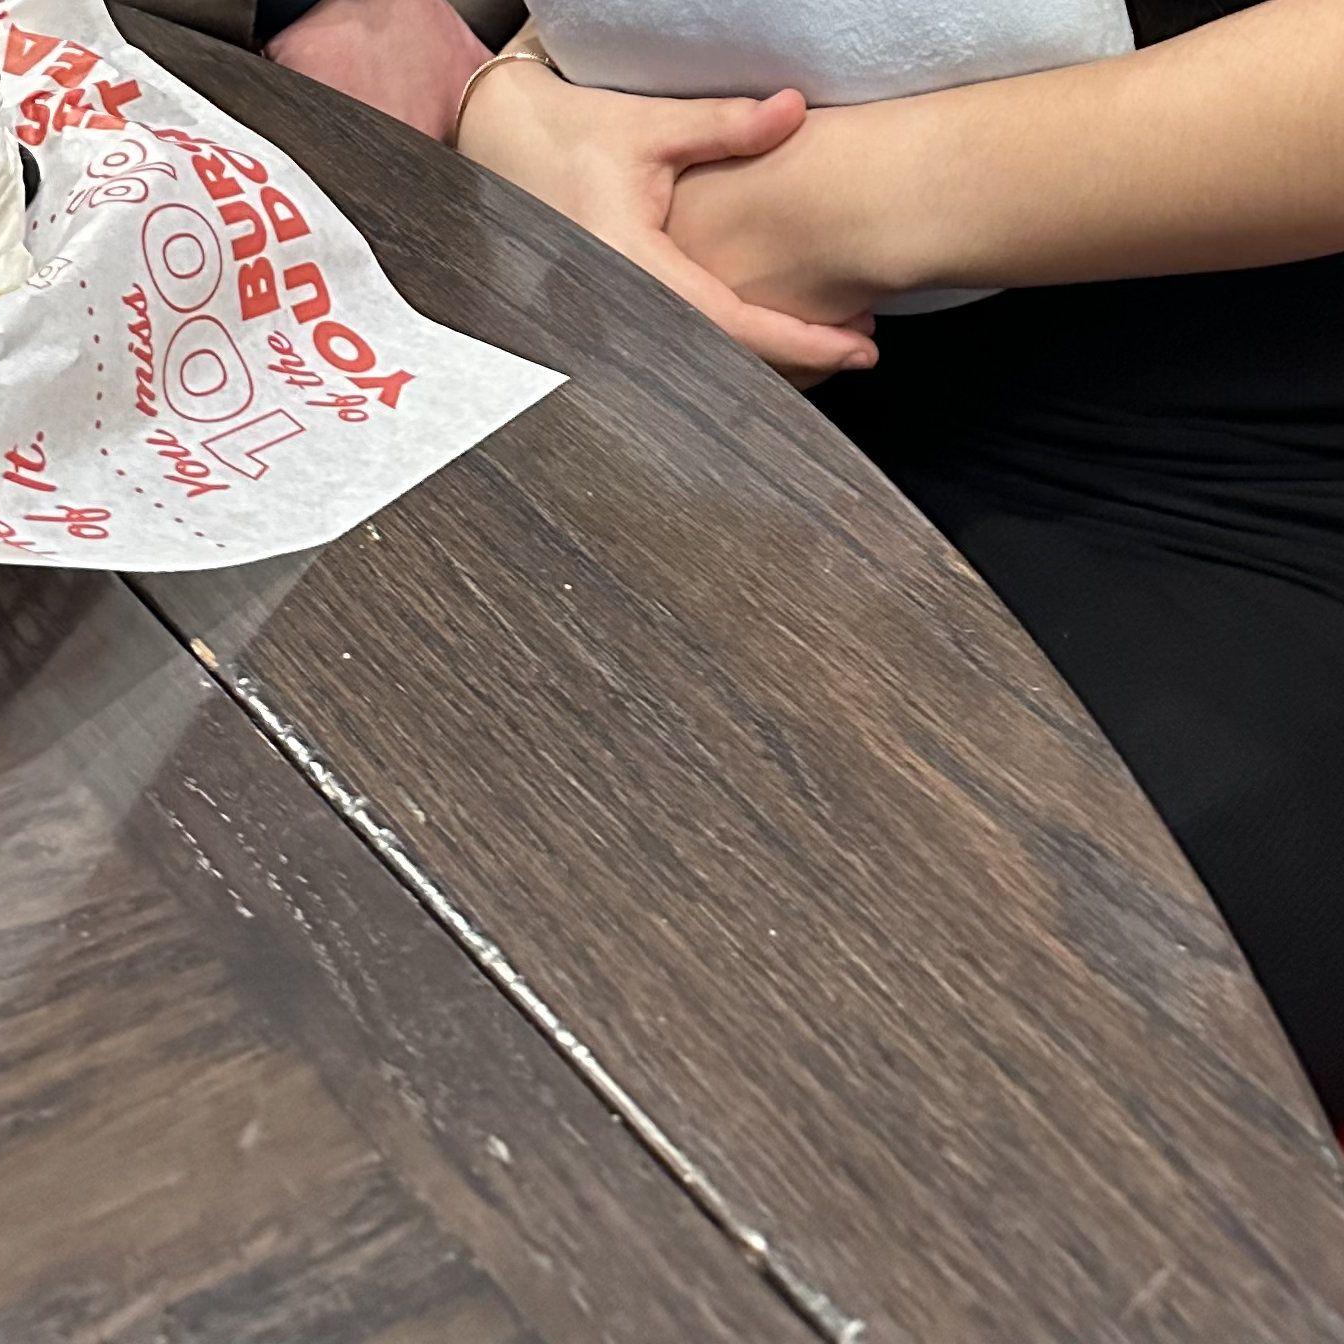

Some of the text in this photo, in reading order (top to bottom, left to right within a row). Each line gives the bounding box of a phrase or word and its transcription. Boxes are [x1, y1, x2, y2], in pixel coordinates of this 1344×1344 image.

[117, 283, 160, 418] miss
[266, 330, 327, 407] the
[283, 259, 416, 412] YOU
